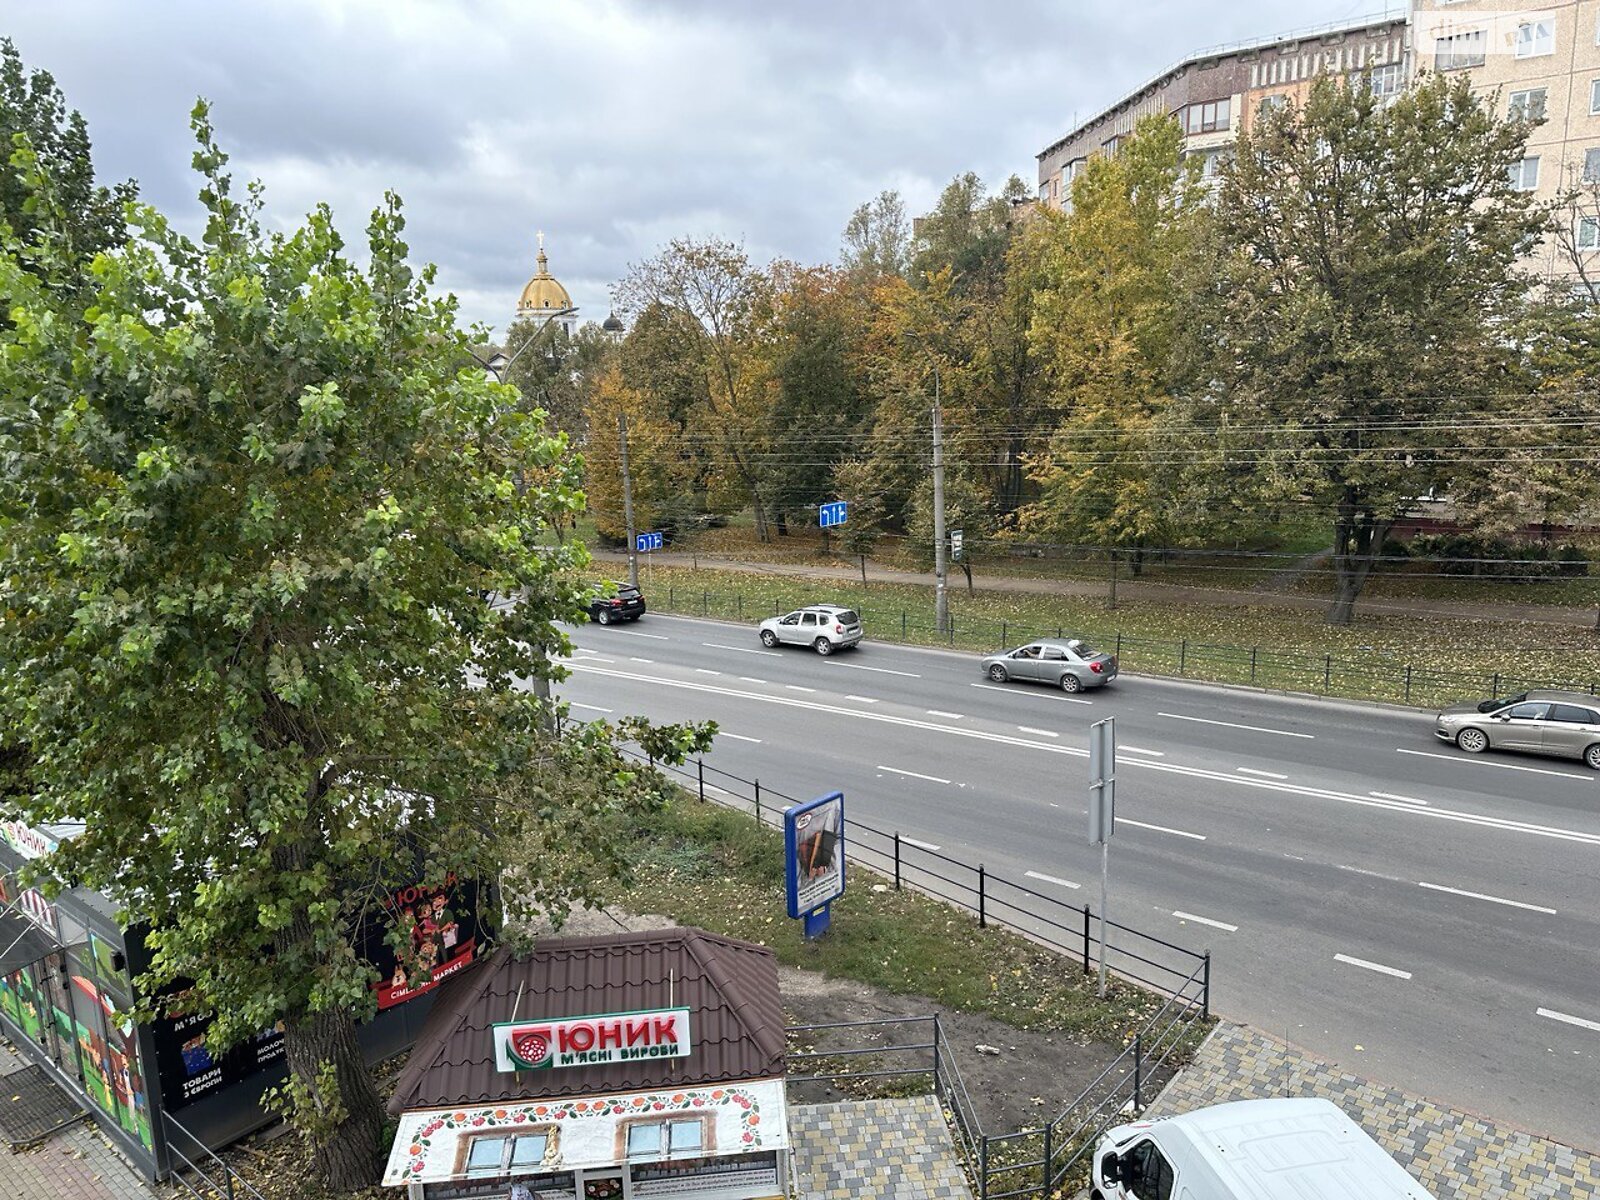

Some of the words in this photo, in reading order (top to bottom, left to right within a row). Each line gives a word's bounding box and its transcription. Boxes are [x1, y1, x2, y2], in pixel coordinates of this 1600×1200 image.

[16, 823, 47, 856] ЮНИК
[433, 961, 463, 982] МАРКЕТ
[558, 1014, 678, 1053] ЮНИК
[561, 1050, 612, 1065] М'ЯСНІ
[621, 1044, 679, 1060] ВИРОБИ
[182, 1067, 221, 1090] ТОВАРИ
[191, 1076, 222, 1095] ЄВРОПИ
